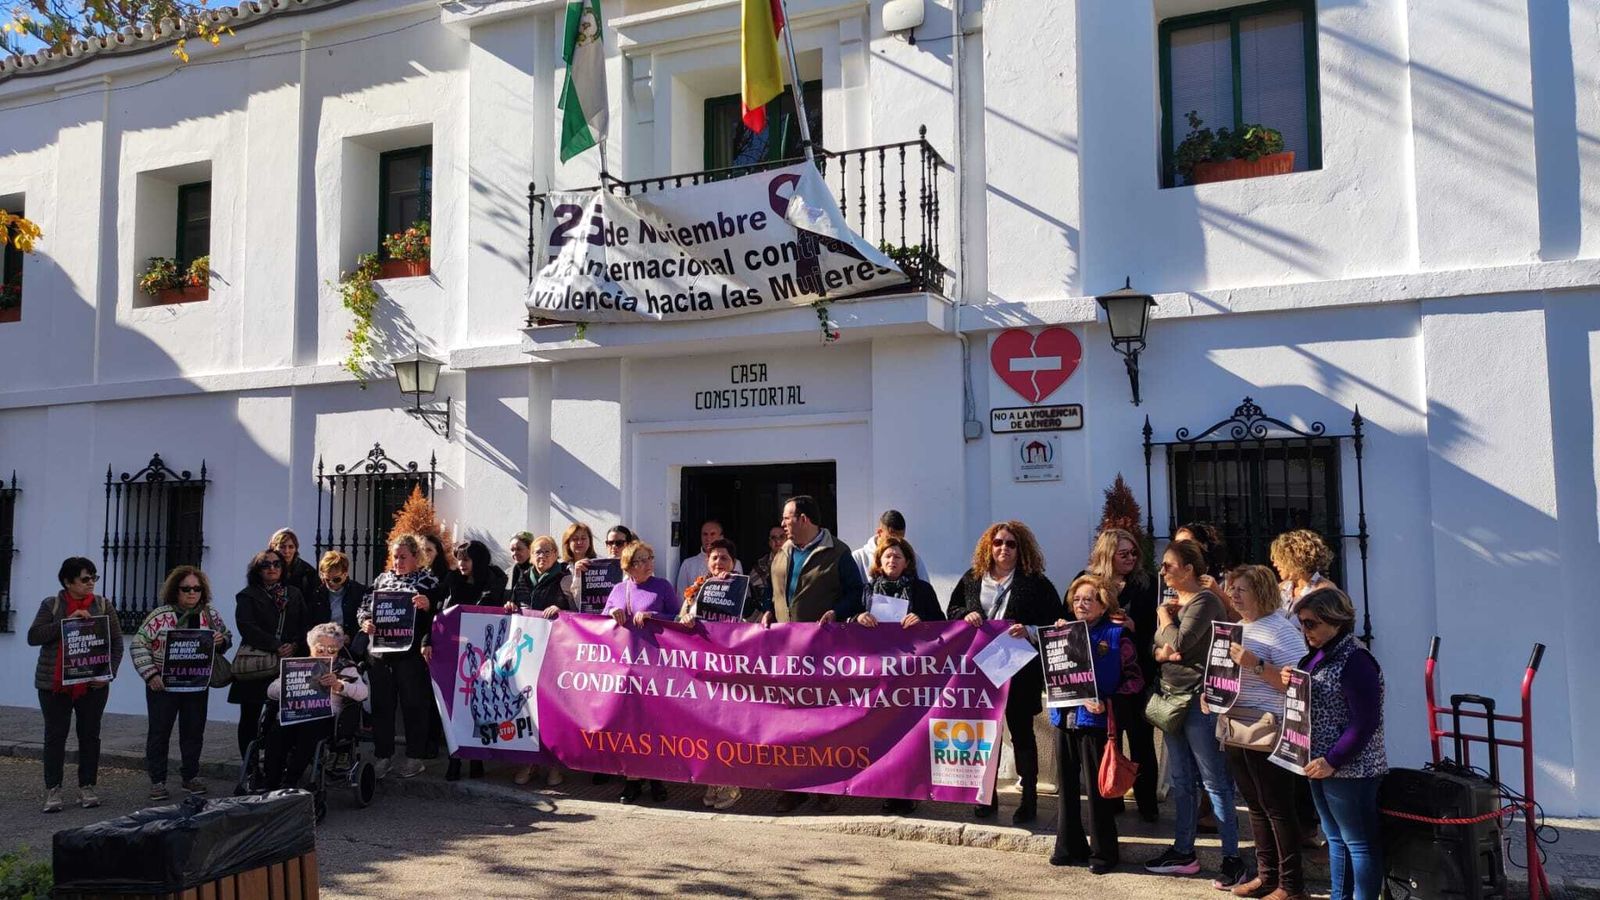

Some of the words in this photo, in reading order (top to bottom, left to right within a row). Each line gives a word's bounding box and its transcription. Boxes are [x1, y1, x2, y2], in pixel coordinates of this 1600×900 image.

[605, 220, 629, 248] de
[534, 285, 638, 312] violencia
[645, 286, 714, 314] hacia
[721, 284, 763, 310] las
[731, 363, 768, 384] CASA
[695, 385, 806, 410] CONSISTORIAL
[994, 412, 1007, 421] NO
[1009, 411, 1015, 420] A
[1017, 411, 1028, 419] LA
[1030, 408, 1078, 419] VIOLENCIA
[1011, 420, 1022, 429] DE
[77, 657, 89, 666] LA
[176, 667, 187, 676] LA
[575, 643, 615, 663] FED.
[619, 646, 650, 666] AA
[657, 648, 697, 670] MM
[704, 651, 816, 676] RURALES
[822, 655, 874, 677] SOL
[880, 654, 977, 677] RURAL
[557, 670, 659, 696] CONDENA
[664, 678, 698, 699] LA
[705, 681, 843, 707] VIOLENCIA
[848, 687, 994, 709] MACHISTA
[1058, 674, 1069, 685] LA
[295, 700, 306, 709] LA
[933, 721, 992, 751] SOL
[580, 729, 652, 756] VIVAS
[659, 735, 708, 761] NOS
[716, 740, 870, 768] QUEREMOS
